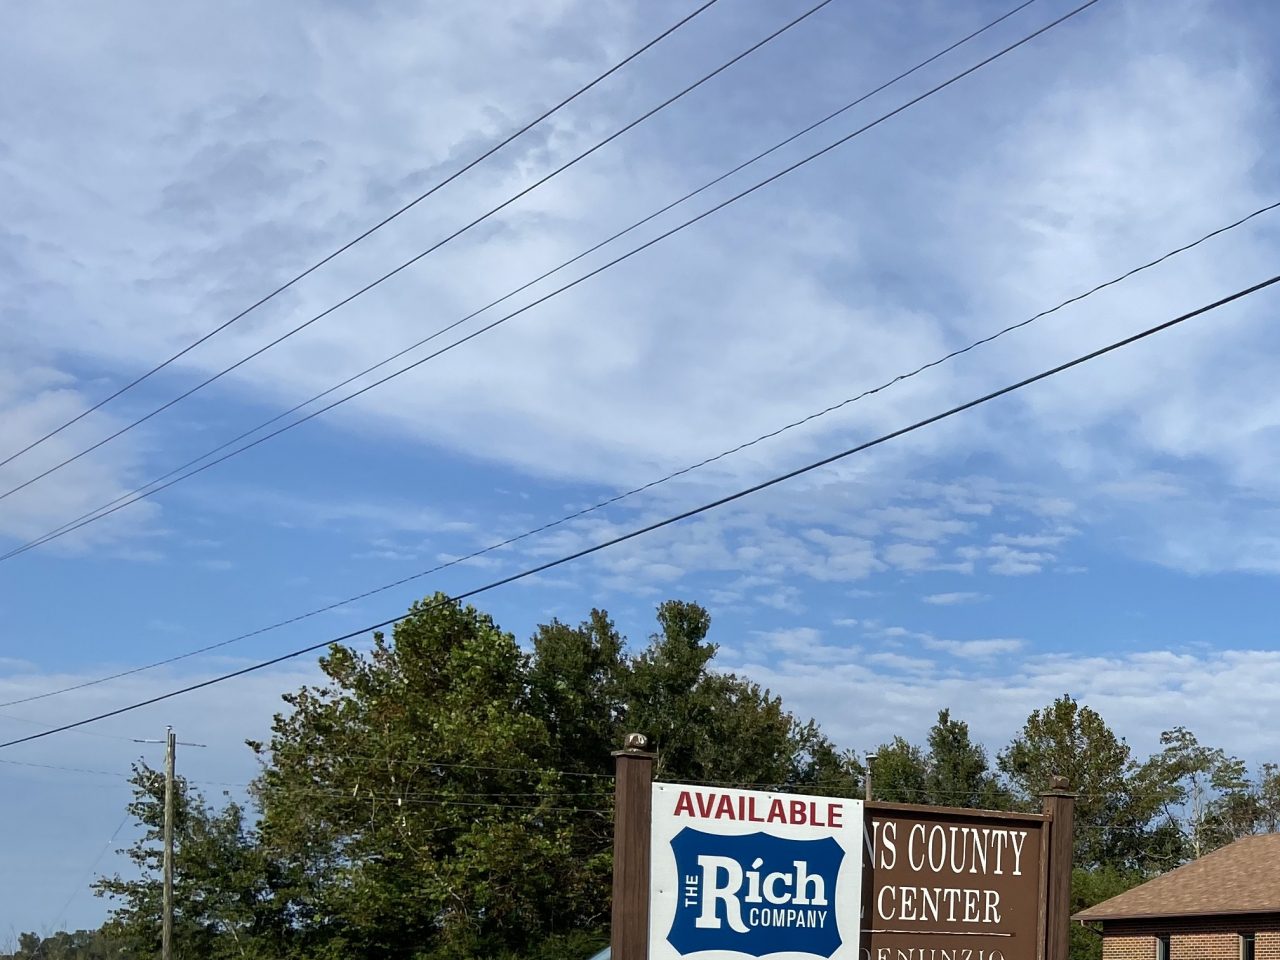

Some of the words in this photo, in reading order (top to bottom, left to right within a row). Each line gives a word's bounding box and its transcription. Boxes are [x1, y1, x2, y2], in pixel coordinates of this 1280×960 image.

[673, 791, 843, 828] AVAILABLE
[863, 821, 897, 870] NS
[908, 823, 1027, 877] COUNTY
[685, 874, 698, 907] THE
[695, 855, 828, 934] Rich
[877, 885, 1001, 924] CENTER
[749, 907, 828, 929] COMPANY
